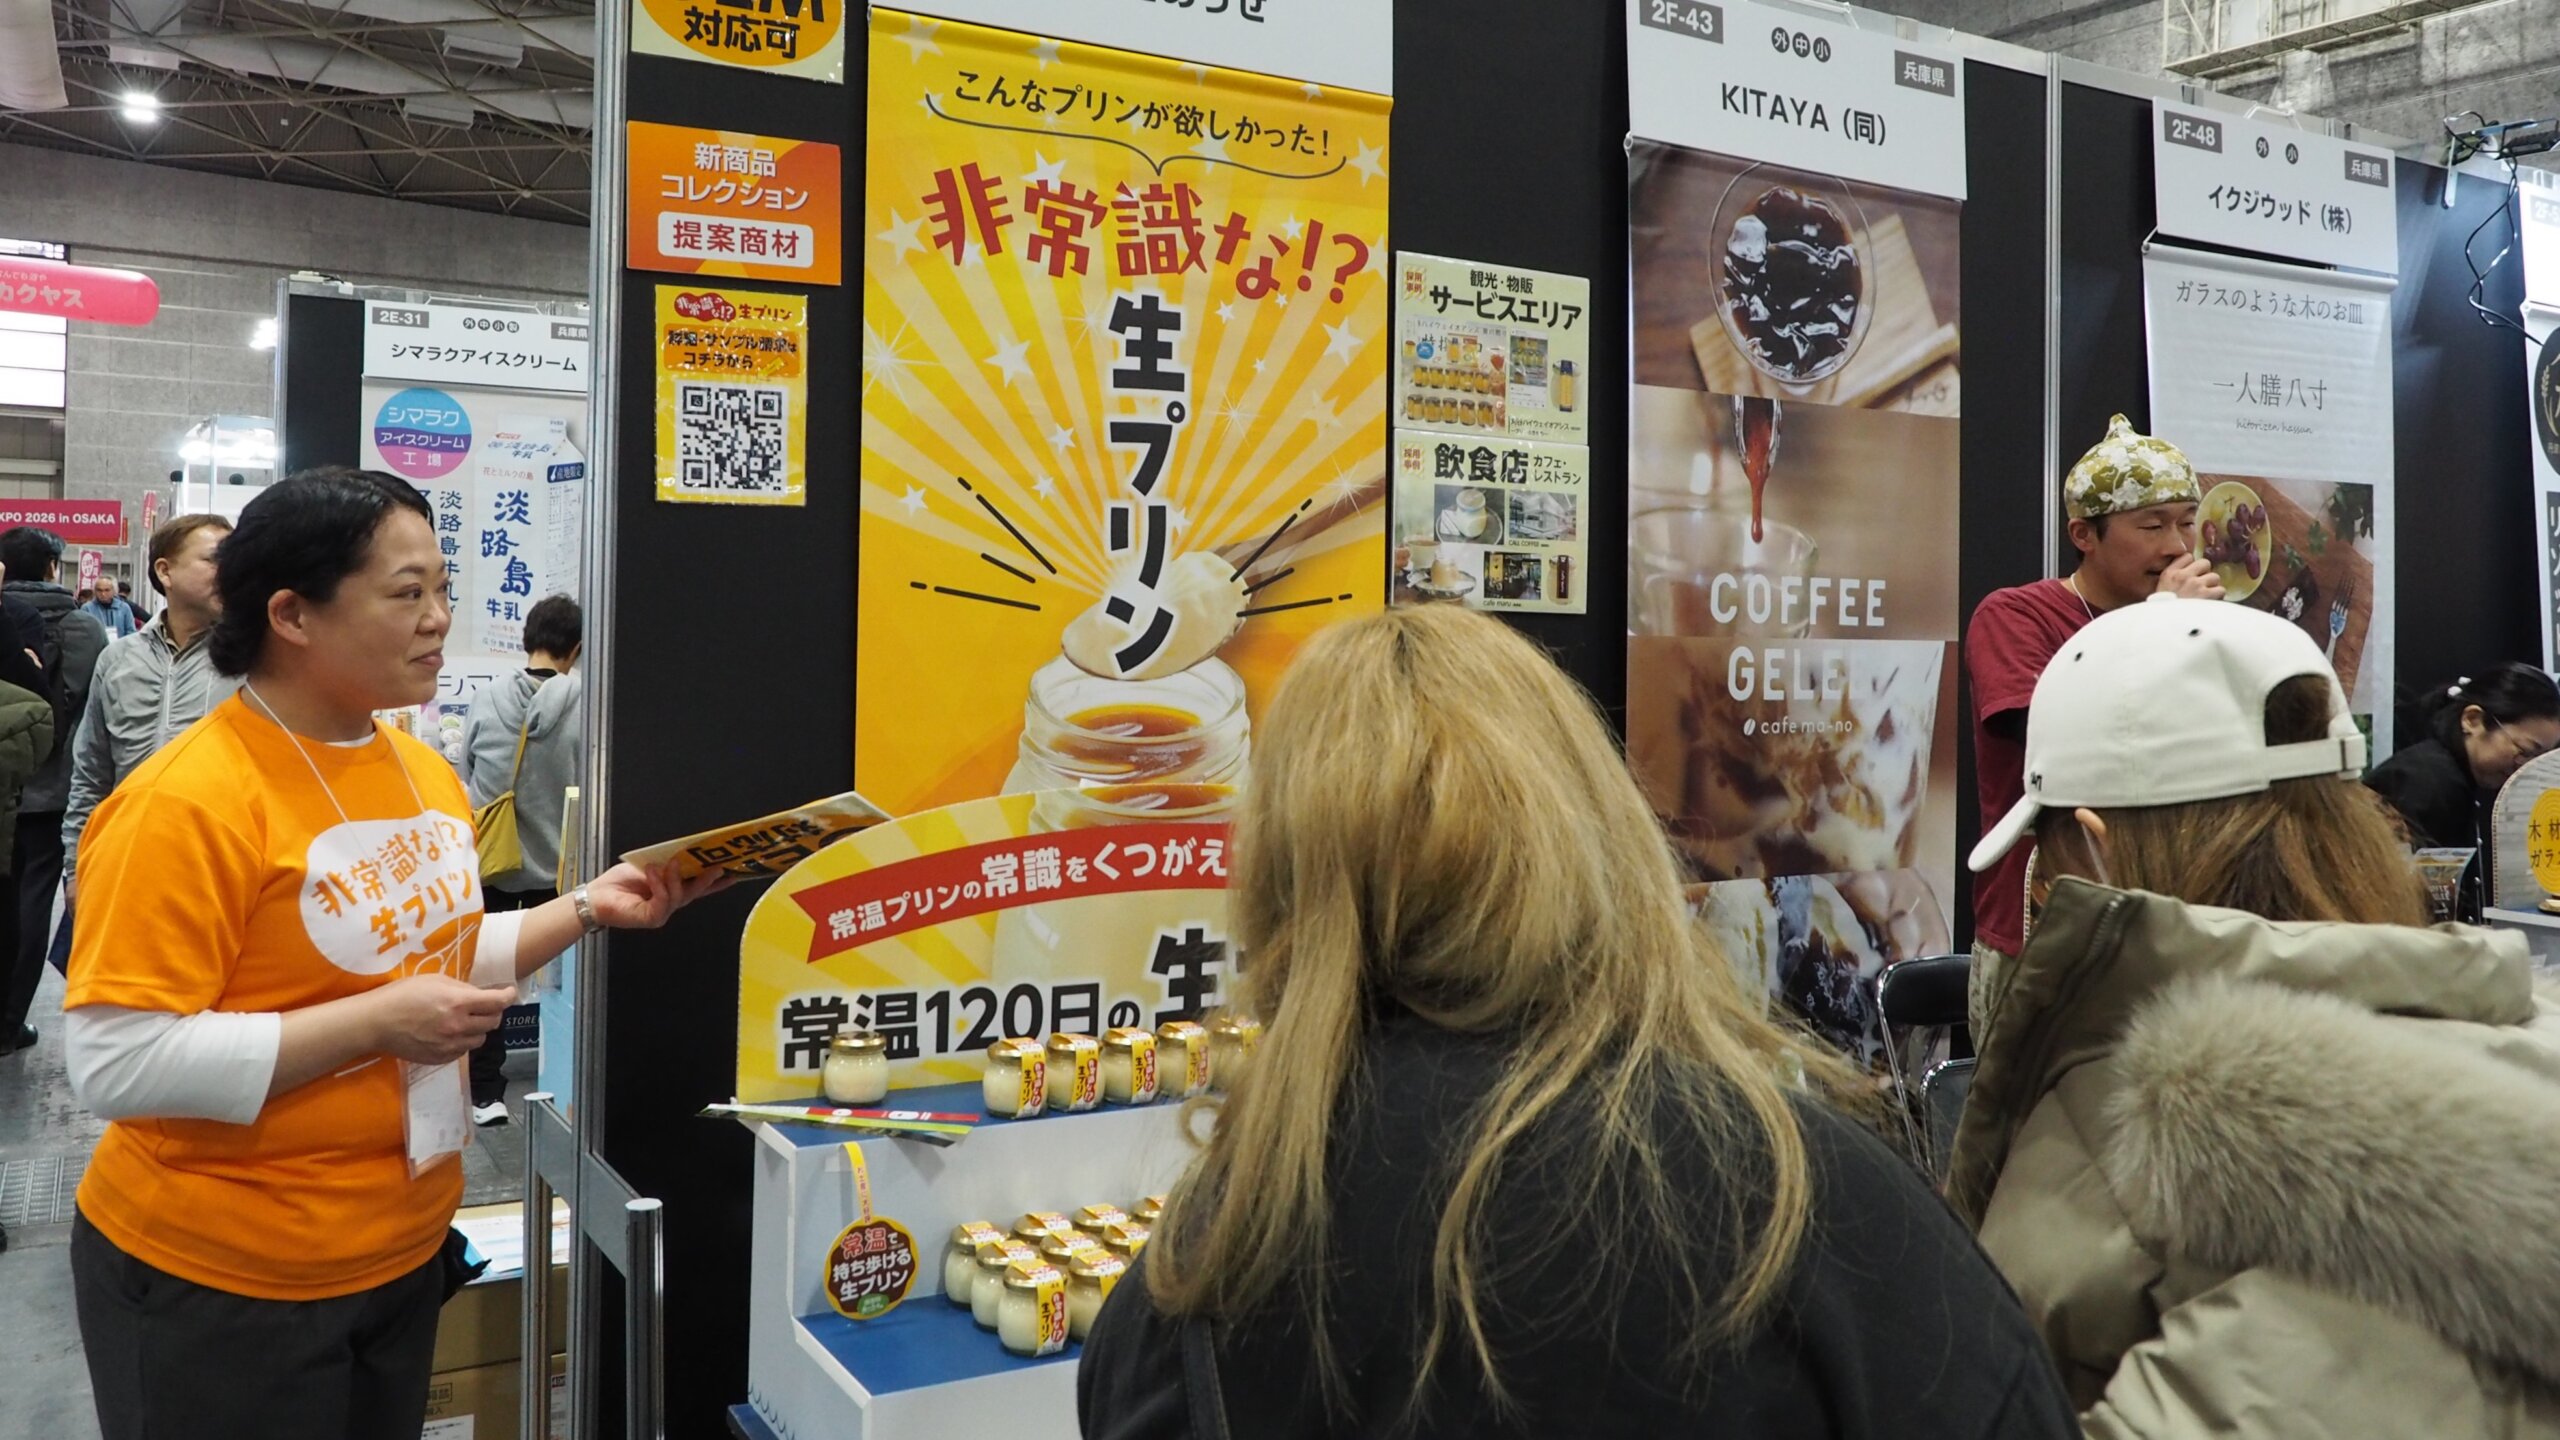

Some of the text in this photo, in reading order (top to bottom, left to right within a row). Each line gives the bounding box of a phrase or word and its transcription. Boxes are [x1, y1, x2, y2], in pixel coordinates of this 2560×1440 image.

[683, 5, 801, 59] 対応可
[1651, 0, 1714, 35] 2F-43
[1903, 61, 1946, 88] 兵庫県
[955, 70, 1329, 157] こんなプリンが欲しかった!
[1721, 82, 1829, 132] KITAYA
[2171, 118, 2216, 147] 2F-48
[694, 141, 776, 178] 新商品
[2350, 157, 2383, 181] 兵庫県
[660, 173, 810, 212] コレクション
[672, 219, 800, 259] 提案商材
[921, 161, 1370, 304] 非常識な!?
[379, 310, 423, 326] 2E-31
[738, 303, 793, 322] 生プリン
[1429, 285, 1582, 331] サービスエリア
[2176, 280, 2364, 326] ガラスのような木のお皿
[391, 343, 577, 372] シマラクアイスクリーム
[683, 351, 754, 370] コチラから
[2212, 371, 2328, 411] 一人膳八寸
[387, 406, 460, 427] シマラク
[380, 432, 465, 449] アイスクリーム
[402, 451, 442, 467] 工場
[1434, 442, 1528, 484] 飲食店
[1105, 294, 1186, 673] 生プリン
[1534, 471, 1582, 486] レストラン
[25, 512, 55, 523] 2026
[59, 513, 69, 523] in
[72, 513, 115, 524] OSAKA
[480, 489, 533, 597] 淡路島
[486, 598, 522, 621] 牛乳
[1710, 573, 1886, 627] COFFEE
[1760, 716, 1853, 735] cafe ma-no
[309, 820, 464, 918] 非常識な!?
[2530, 849, 2560, 869] ガラ
[369, 868, 473, 956] 生プリン
[505, 1015, 537, 1026] STORE
[841, 1227, 899, 1260] 常温で
[833, 1248, 912, 1283] 持ち歩ける
[840, 1268, 909, 1302] 生プリン
